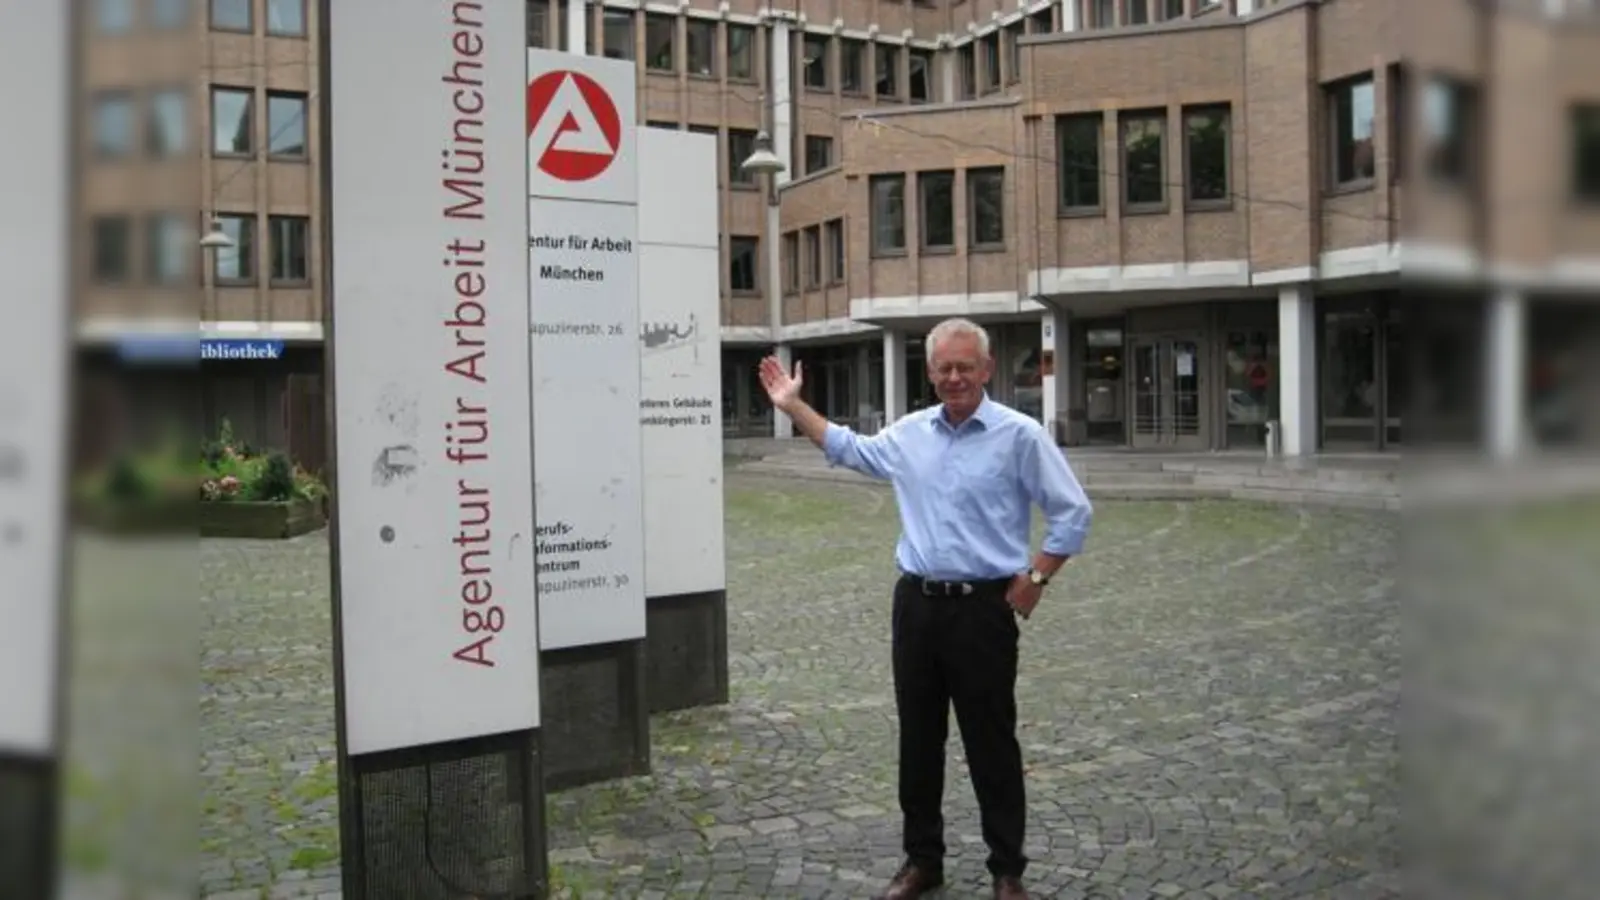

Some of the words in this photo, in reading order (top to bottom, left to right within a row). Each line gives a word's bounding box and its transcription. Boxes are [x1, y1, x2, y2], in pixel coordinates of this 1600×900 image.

[442, 1, 484, 220] München
[540, 265, 604, 281] München
[568, 235, 588, 250] für
[591, 237, 632, 253] Arbeit
[443, 239, 487, 383] Arbeit
[201, 343, 278, 359] ibliothek
[446, 397, 488, 464] für
[452, 479, 505, 667] Agentur
